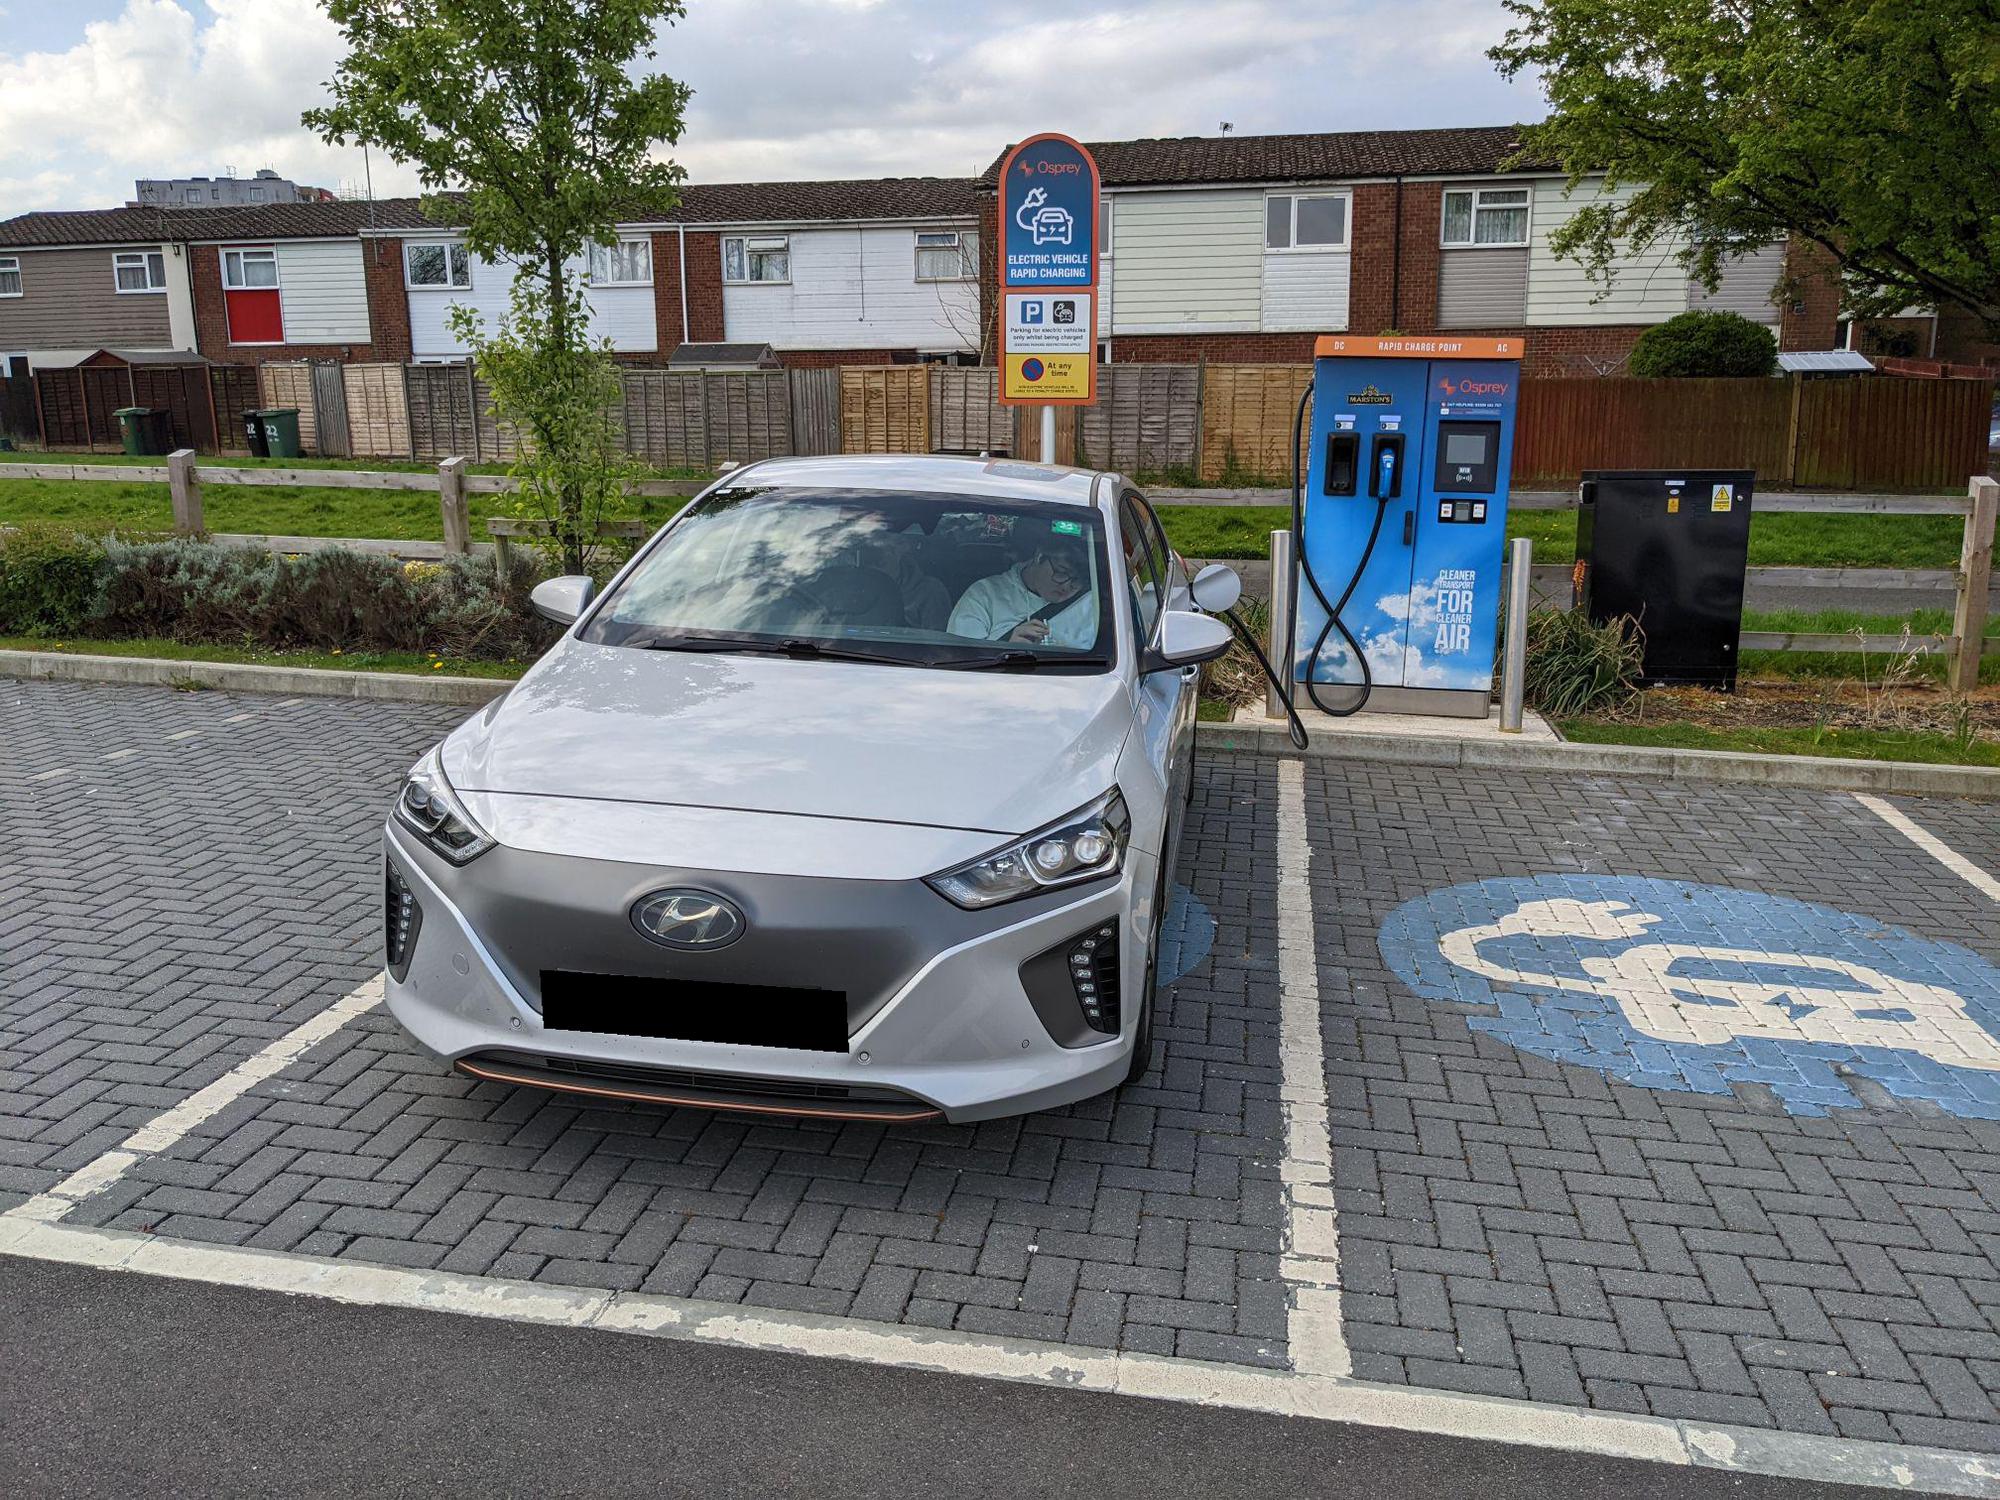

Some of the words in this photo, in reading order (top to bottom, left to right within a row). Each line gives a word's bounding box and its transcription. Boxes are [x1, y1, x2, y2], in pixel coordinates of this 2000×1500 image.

[1037, 160, 1081, 175] Osprey
[1008, 254, 1050, 264] ELECTRIC
[1052, 254, 1088, 264] VEHICLE
[1011, 268, 1037, 278] RAPID
[1040, 268, 1086, 278] CHARGING
[1026, 303, 1040, 322] P
[1334, 341, 1345, 350] DC
[1378, 342, 1402, 351] RAPID
[1404, 342, 1436, 351] CHARGE
[1438, 342, 1462, 352] POINT
[1496, 343, 1508, 352] AC
[1460, 379, 1508, 395] Osprey
[265, 424, 278, 436] 22
[1439, 569, 1476, 580] CLEANER
[1439, 580, 1475, 589] TRANSPORT
[1436, 590, 1473, 613] FOR
[1436, 613, 1472, 624] CLEANER
[1434, 624, 1471, 650] AIR
